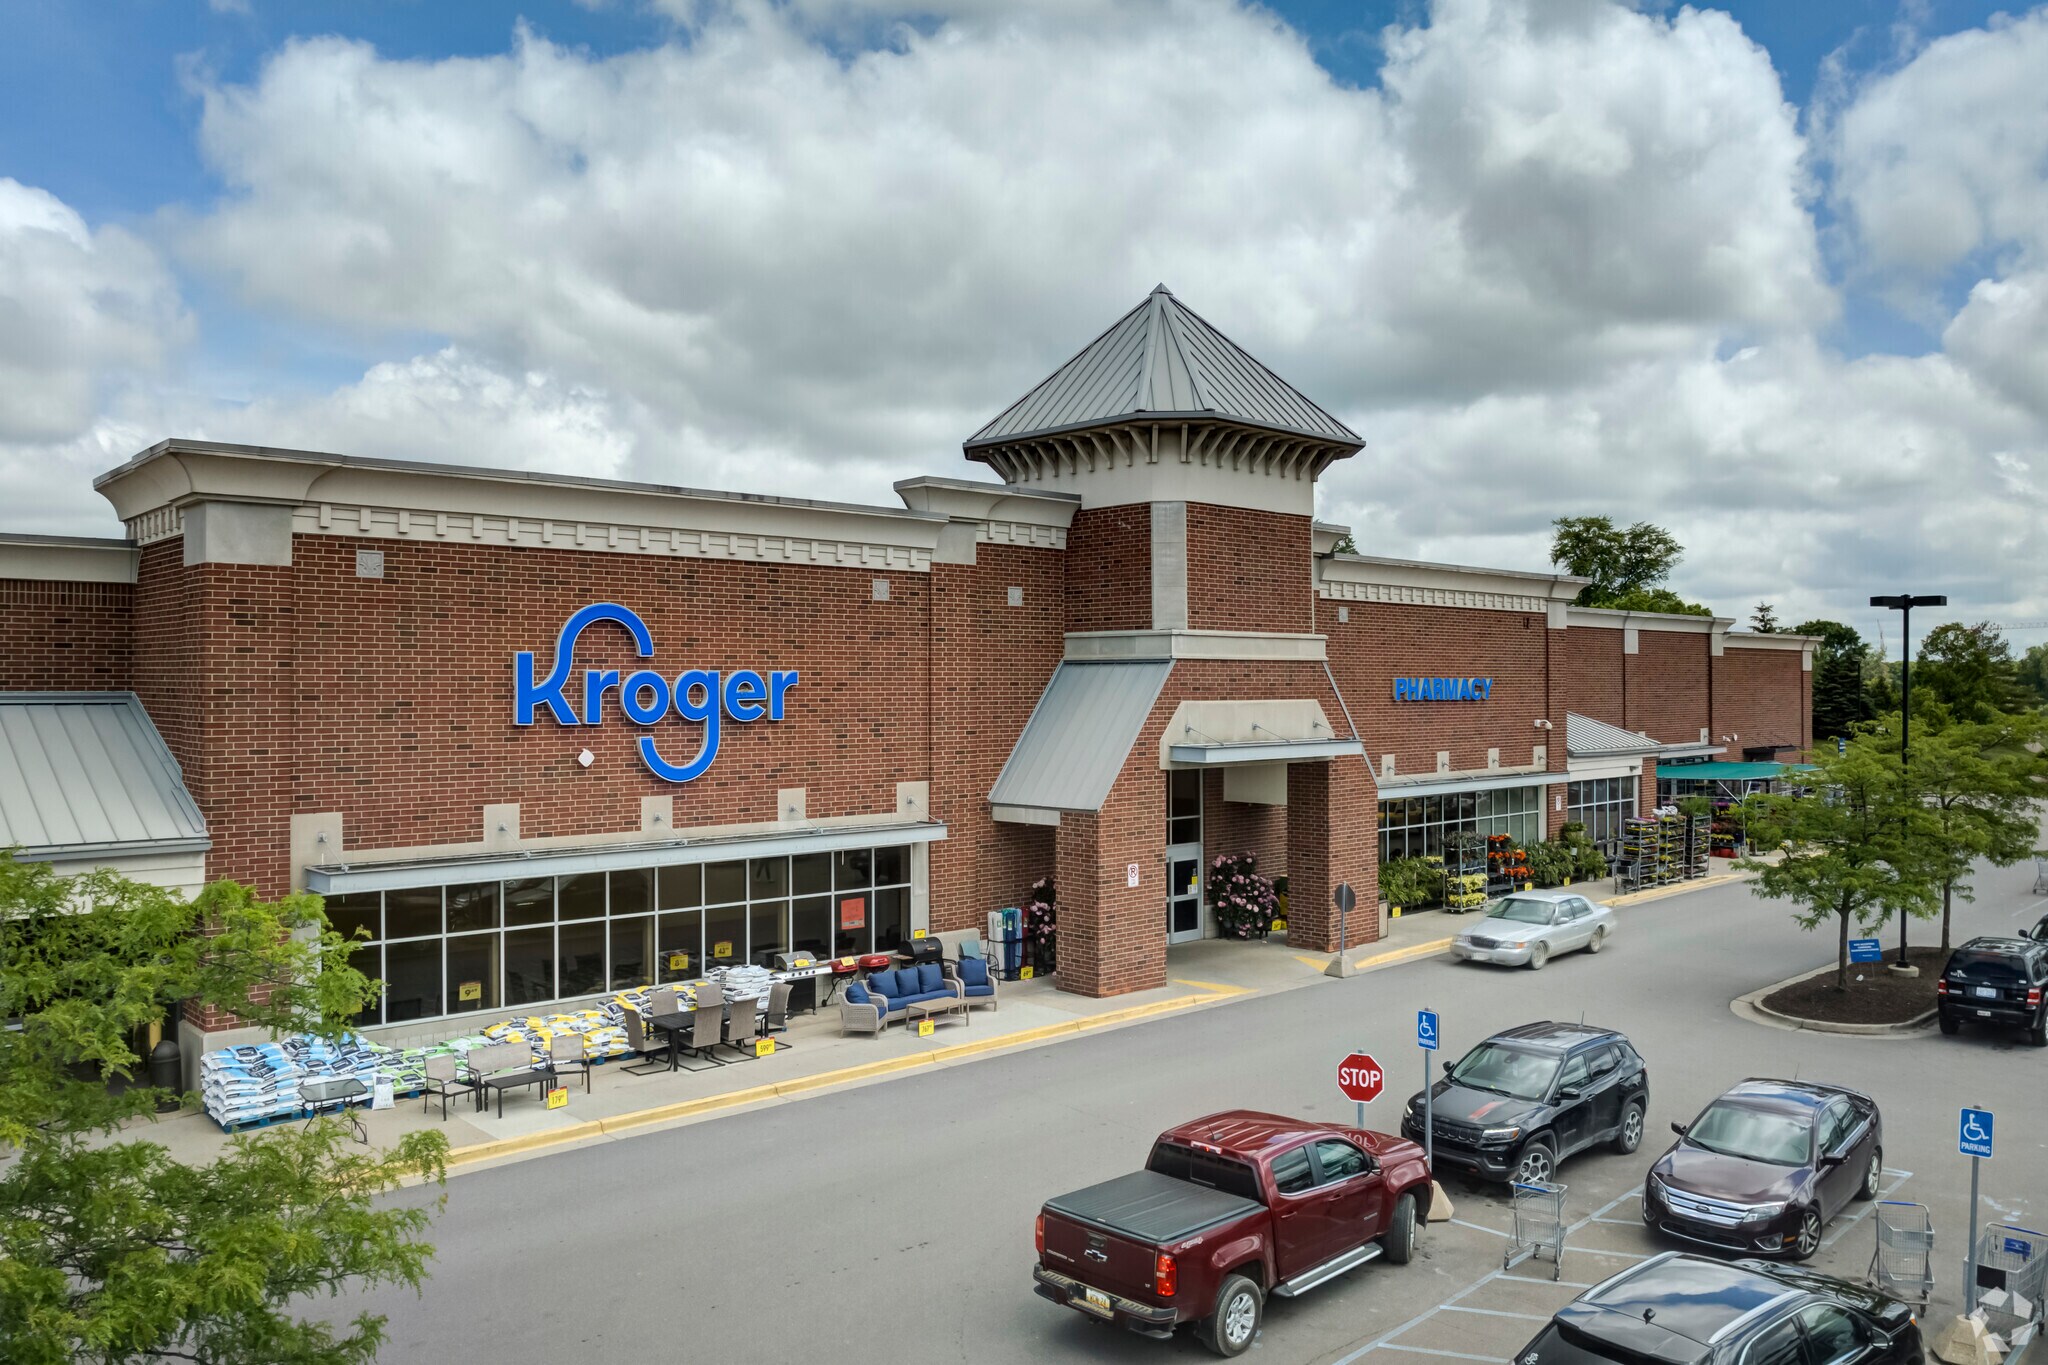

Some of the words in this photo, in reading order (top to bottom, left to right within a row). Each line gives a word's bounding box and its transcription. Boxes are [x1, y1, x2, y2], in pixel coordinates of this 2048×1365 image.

[513, 602, 799, 783] Kroger
[1393, 677, 1493, 702] PHARMACY
[1418, 1037, 1436, 1046] PARKING
[1340, 1067, 1381, 1088] STOP
[1961, 1141, 1991, 1154] PARKING
